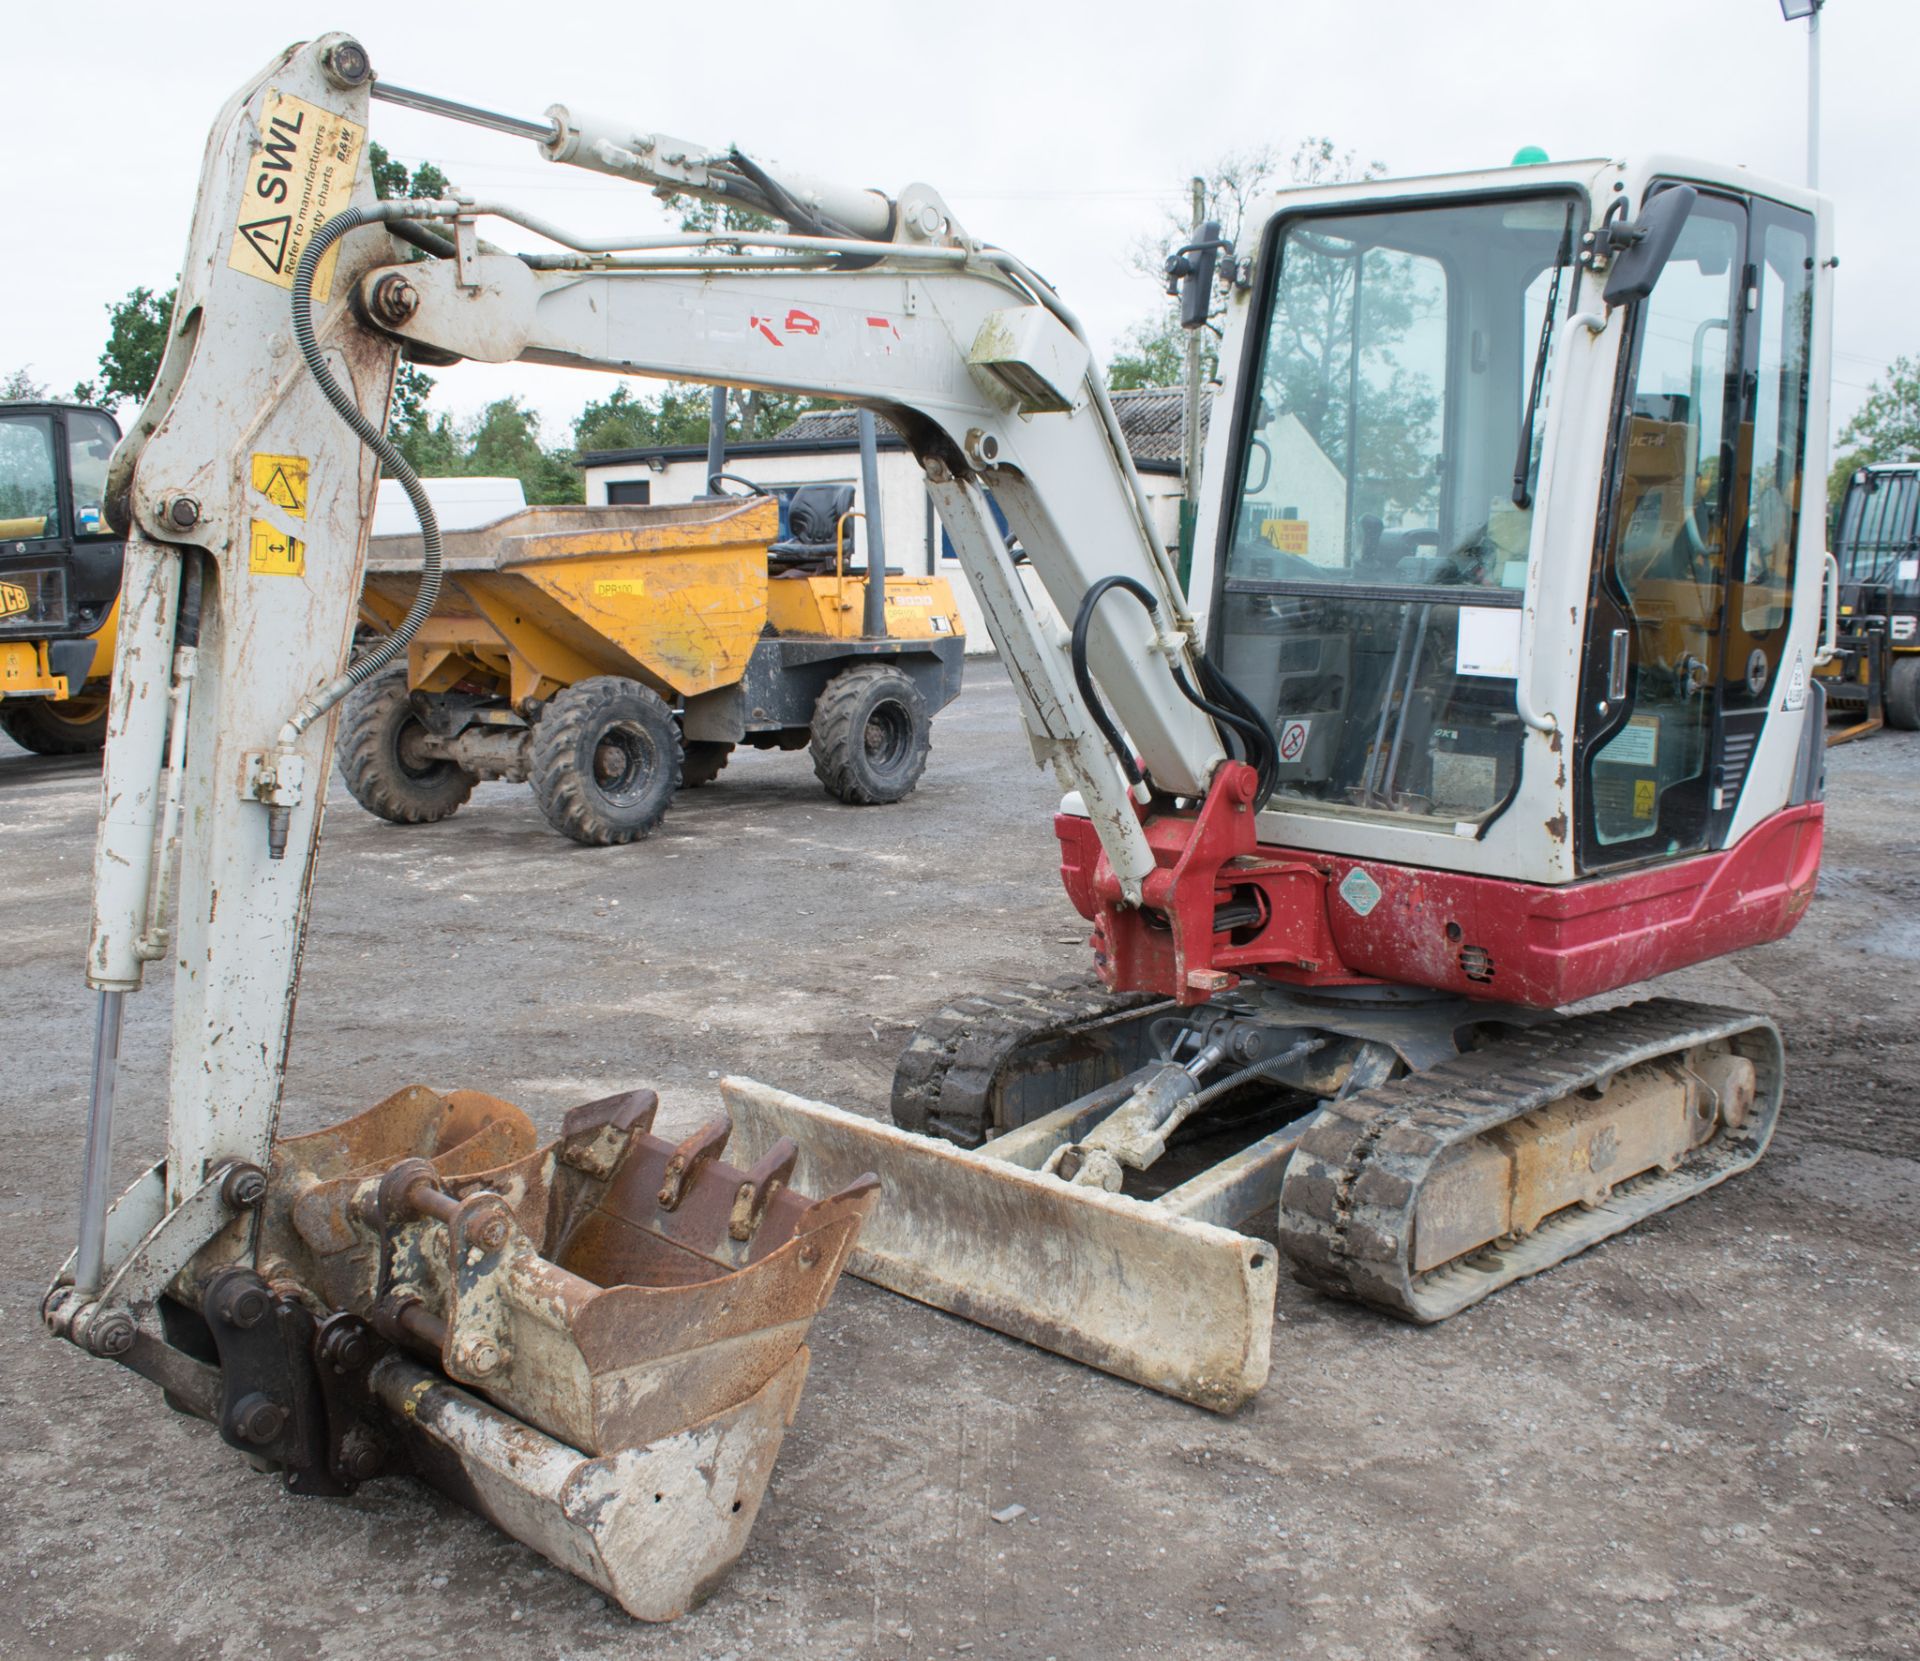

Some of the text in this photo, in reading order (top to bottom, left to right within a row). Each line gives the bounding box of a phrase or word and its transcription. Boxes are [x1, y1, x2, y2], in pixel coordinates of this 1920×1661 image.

[257, 112, 304, 204] SWL
[337, 127, 350, 162] B&W
[284, 125, 326, 275] Refer to manufacturers
[318, 166, 334, 207] charts
